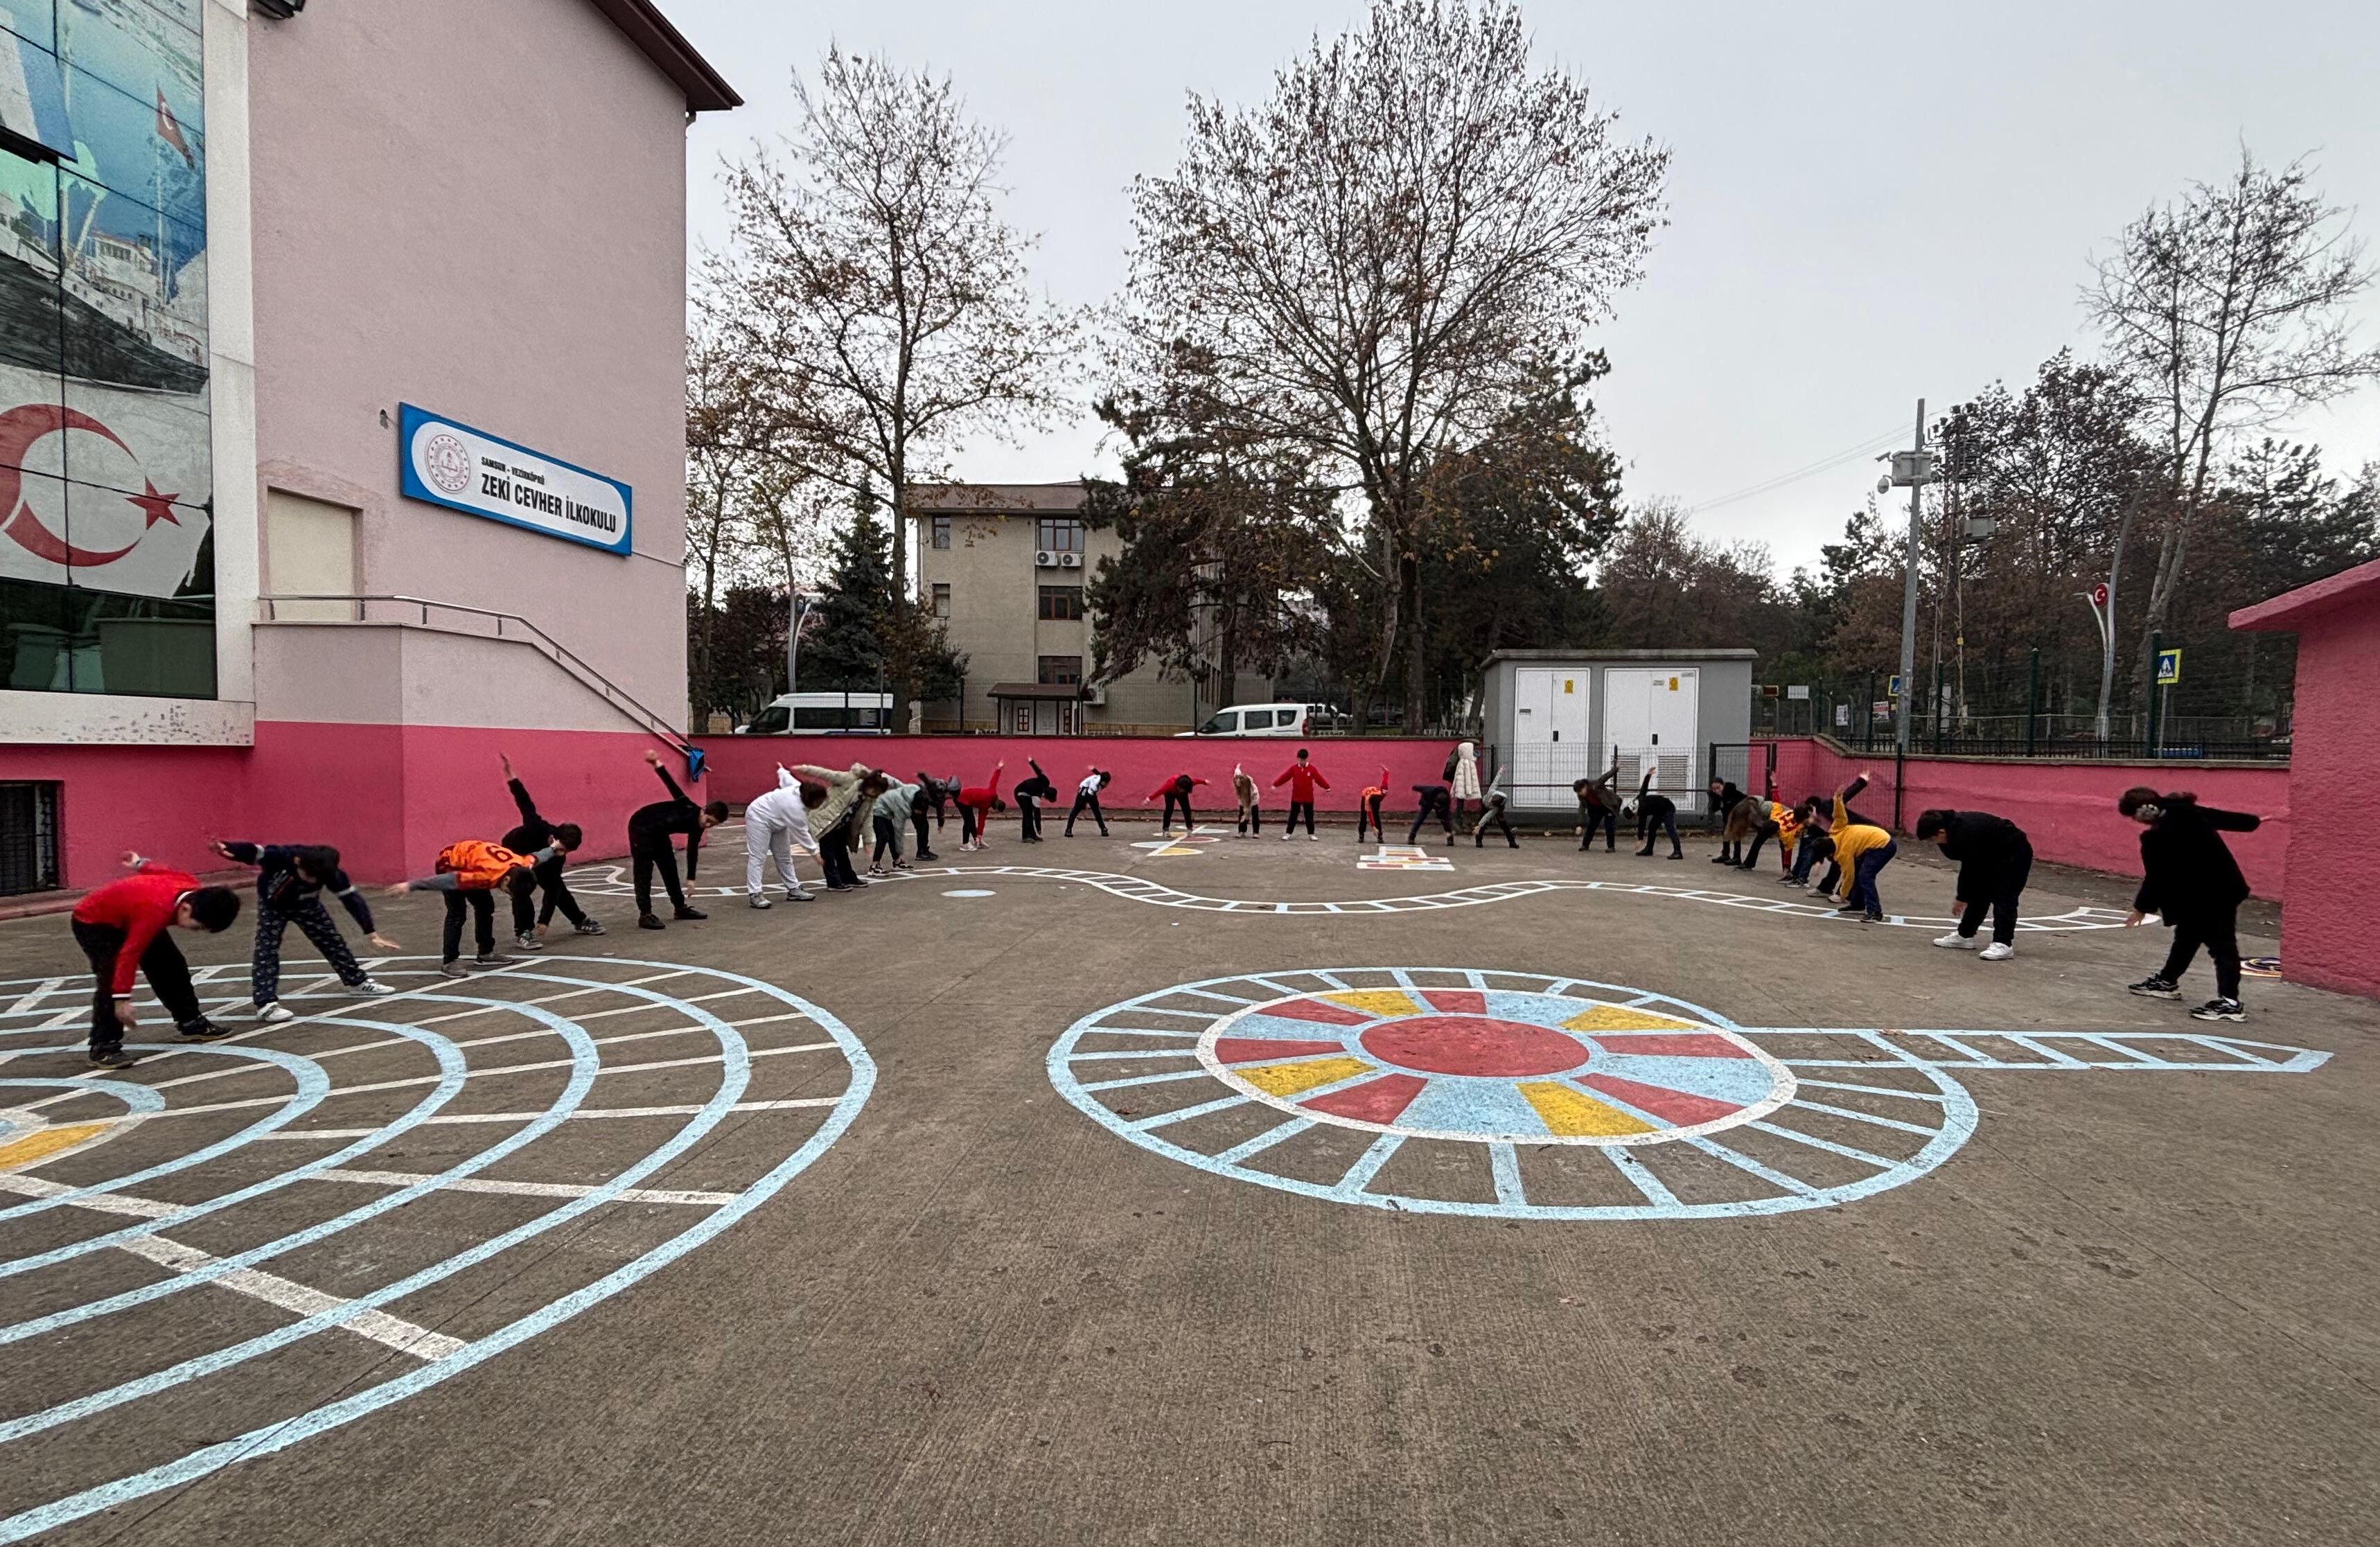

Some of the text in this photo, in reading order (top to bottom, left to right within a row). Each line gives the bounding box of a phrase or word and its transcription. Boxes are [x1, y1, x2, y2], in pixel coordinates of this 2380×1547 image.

[481, 456, 506, 473] SAMSUN
[481, 472, 617, 533] ZEKİ CEVHER İLKOKULU
